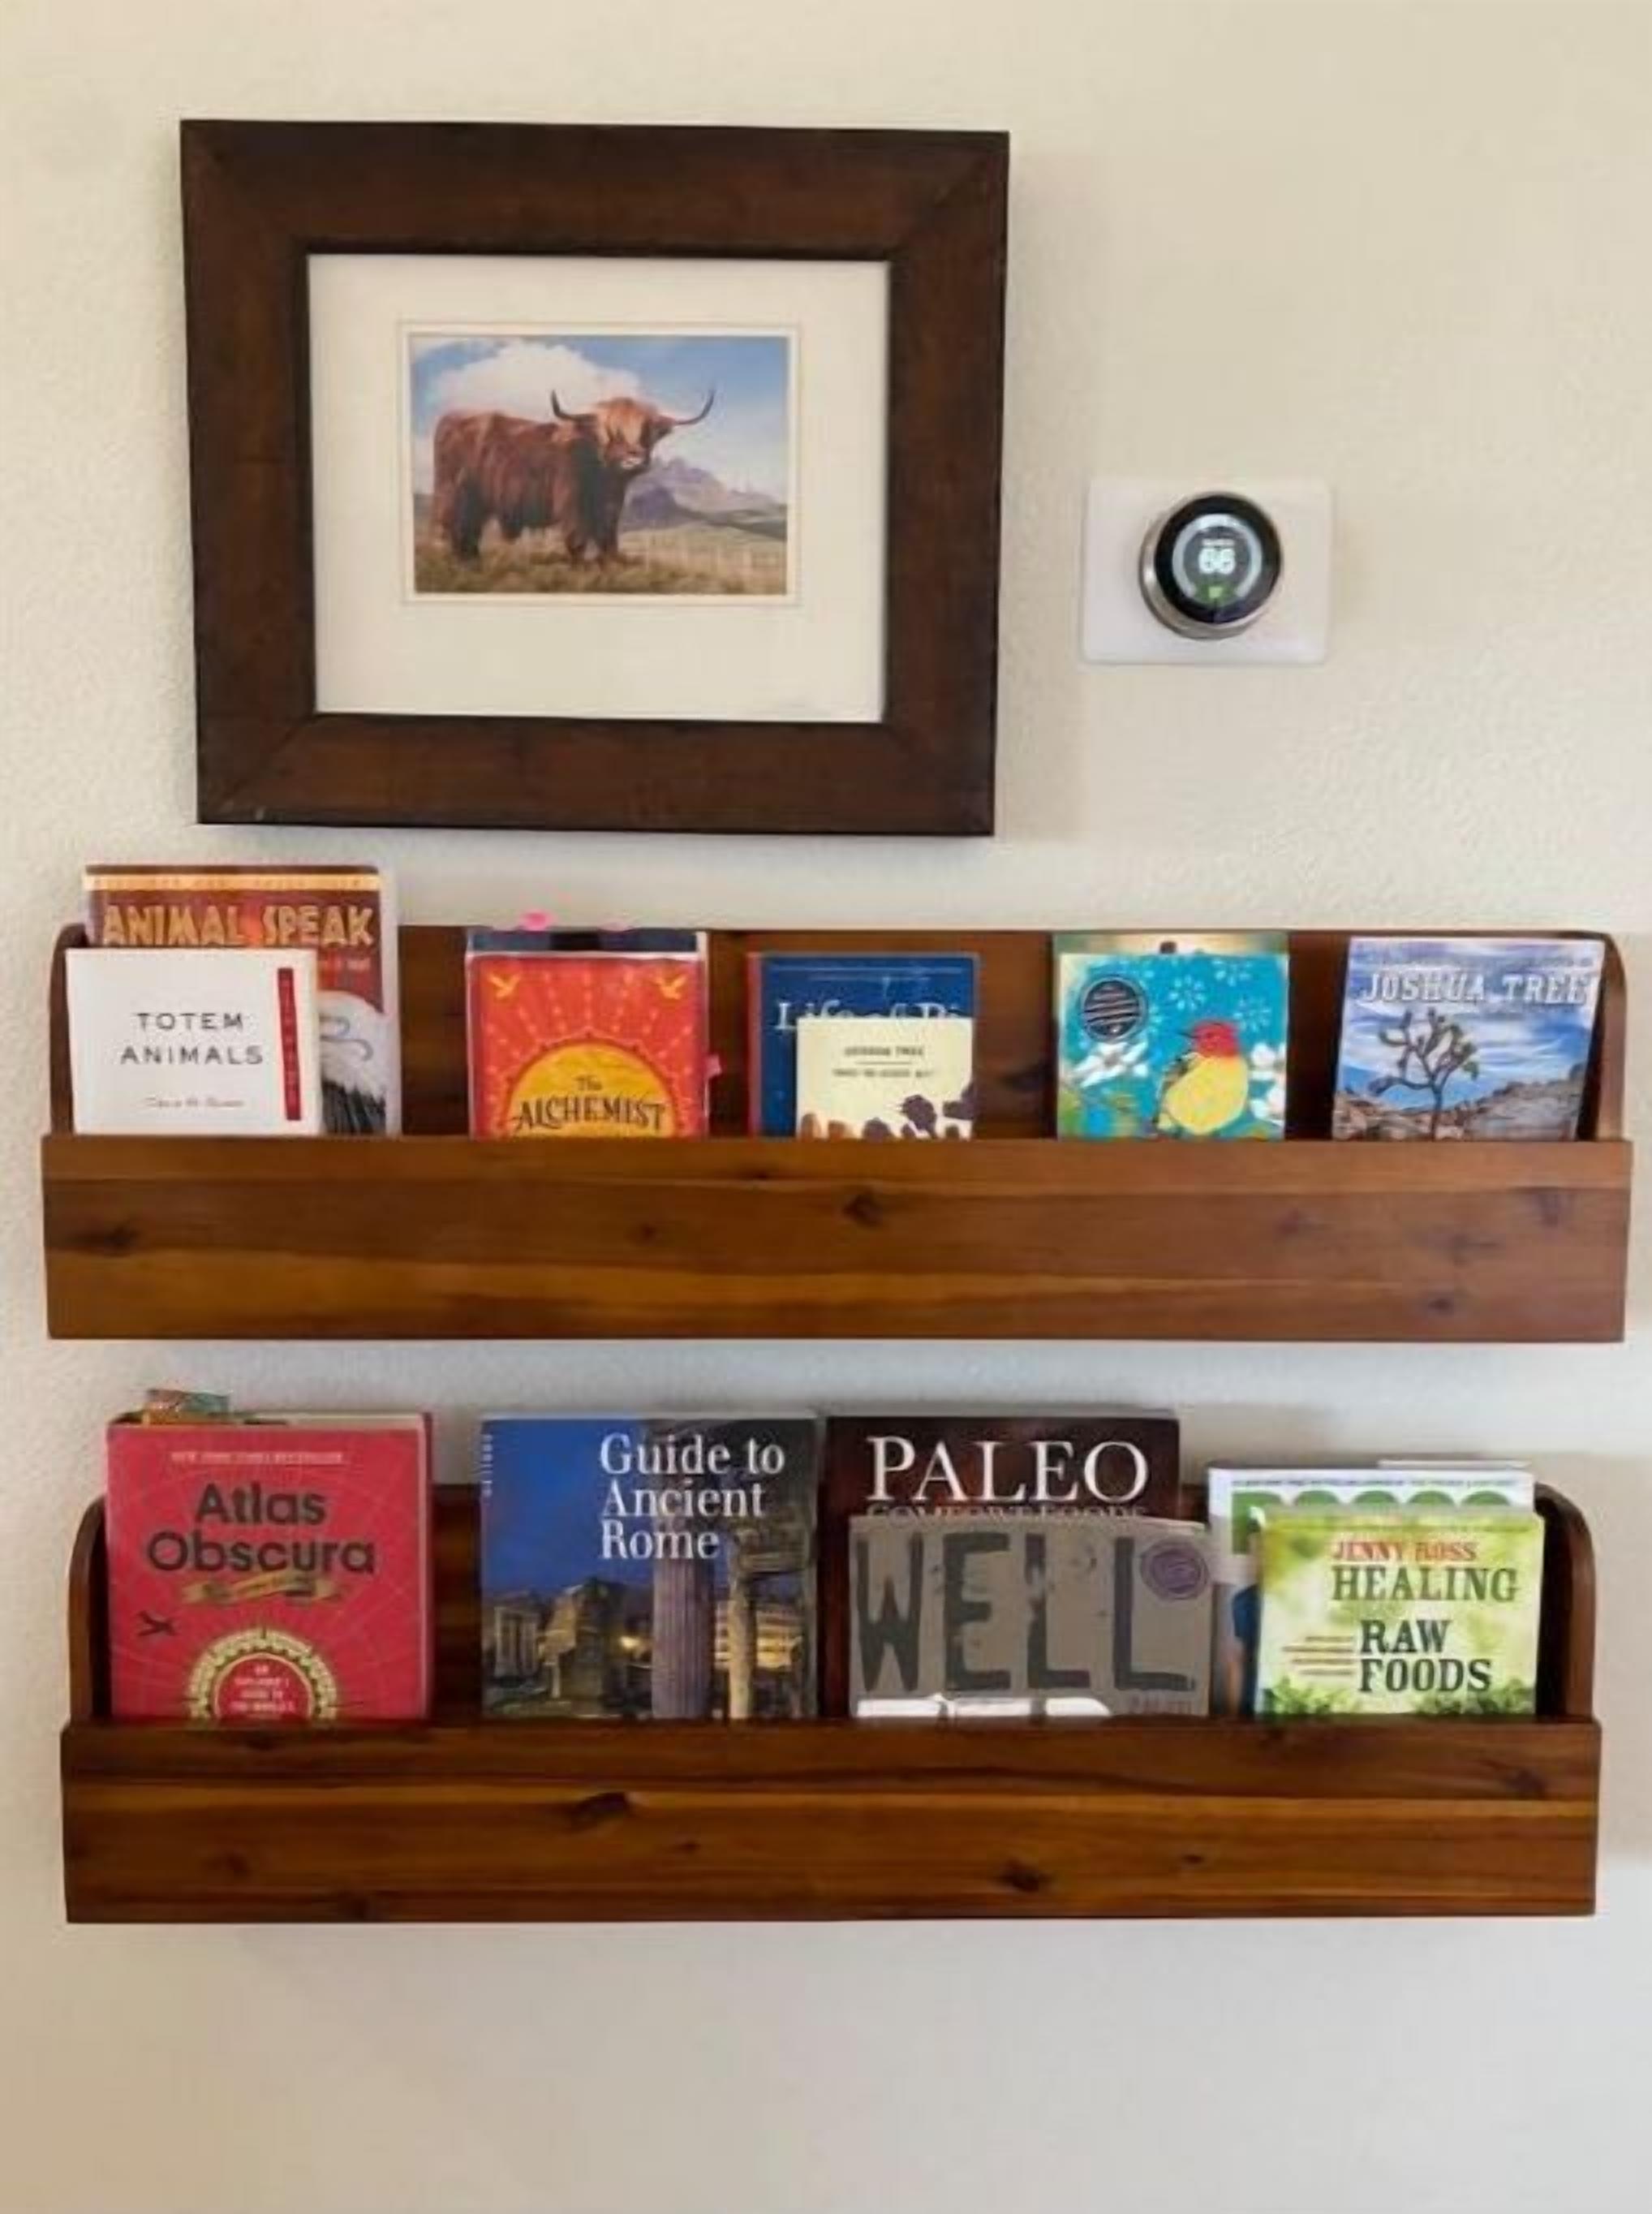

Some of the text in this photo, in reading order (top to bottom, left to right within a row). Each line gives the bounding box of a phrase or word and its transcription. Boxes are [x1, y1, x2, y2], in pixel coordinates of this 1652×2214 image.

[102, 904, 374, 946] ANIMAL SPEAK
[1362, 972, 1591, 1005] JOSHUA TREE
[136, 1013, 243, 1031] TOTEM
[120, 1046, 264, 1065] ANIMALS
[575, 1075, 603, 1092] The
[512, 1096, 666, 1131] ALCHEMIST
[600, 1433, 786, 1475] Guide to
[866, 1436, 1149, 1503] PALEO
[195, 1482, 327, 1525] Atlas
[601, 1480, 767, 1518] Ancient
[147, 1531, 376, 1574] Obscura
[600, 1518, 721, 1560] Rome
[1332, 1540, 1405, 1561] JENNY
[1331, 1565, 1520, 1601] HEALING
[856, 1531, 1196, 1691] WELL
[1359, 1619, 1452, 1655] RAW
[1359, 1659, 1492, 1692] FOODS
